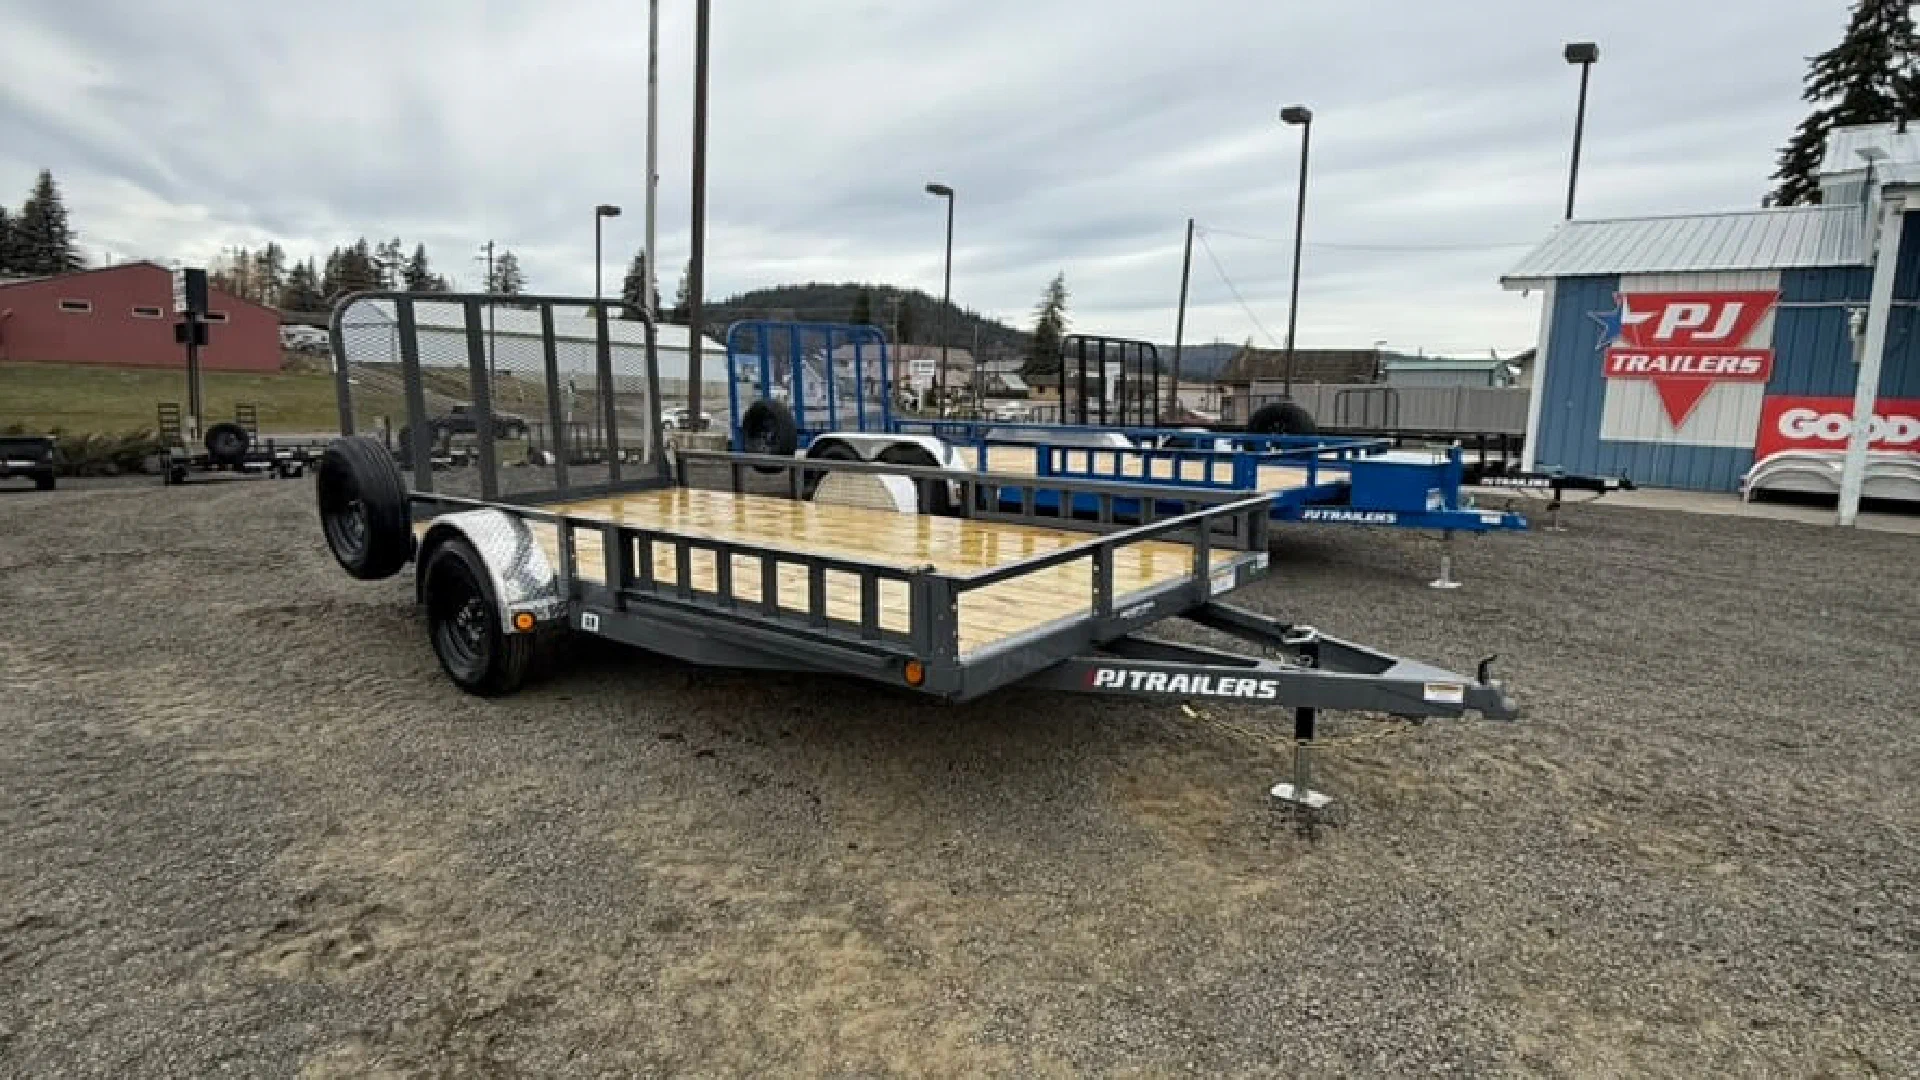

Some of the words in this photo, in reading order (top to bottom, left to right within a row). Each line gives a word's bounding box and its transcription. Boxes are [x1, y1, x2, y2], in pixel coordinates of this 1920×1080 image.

[1653, 302, 1745, 340] PJ
[1611, 355, 1764, 374] TRAILERS
[1093, 668, 1127, 688] PJ
[1129, 671, 1280, 698] TRAILERS
